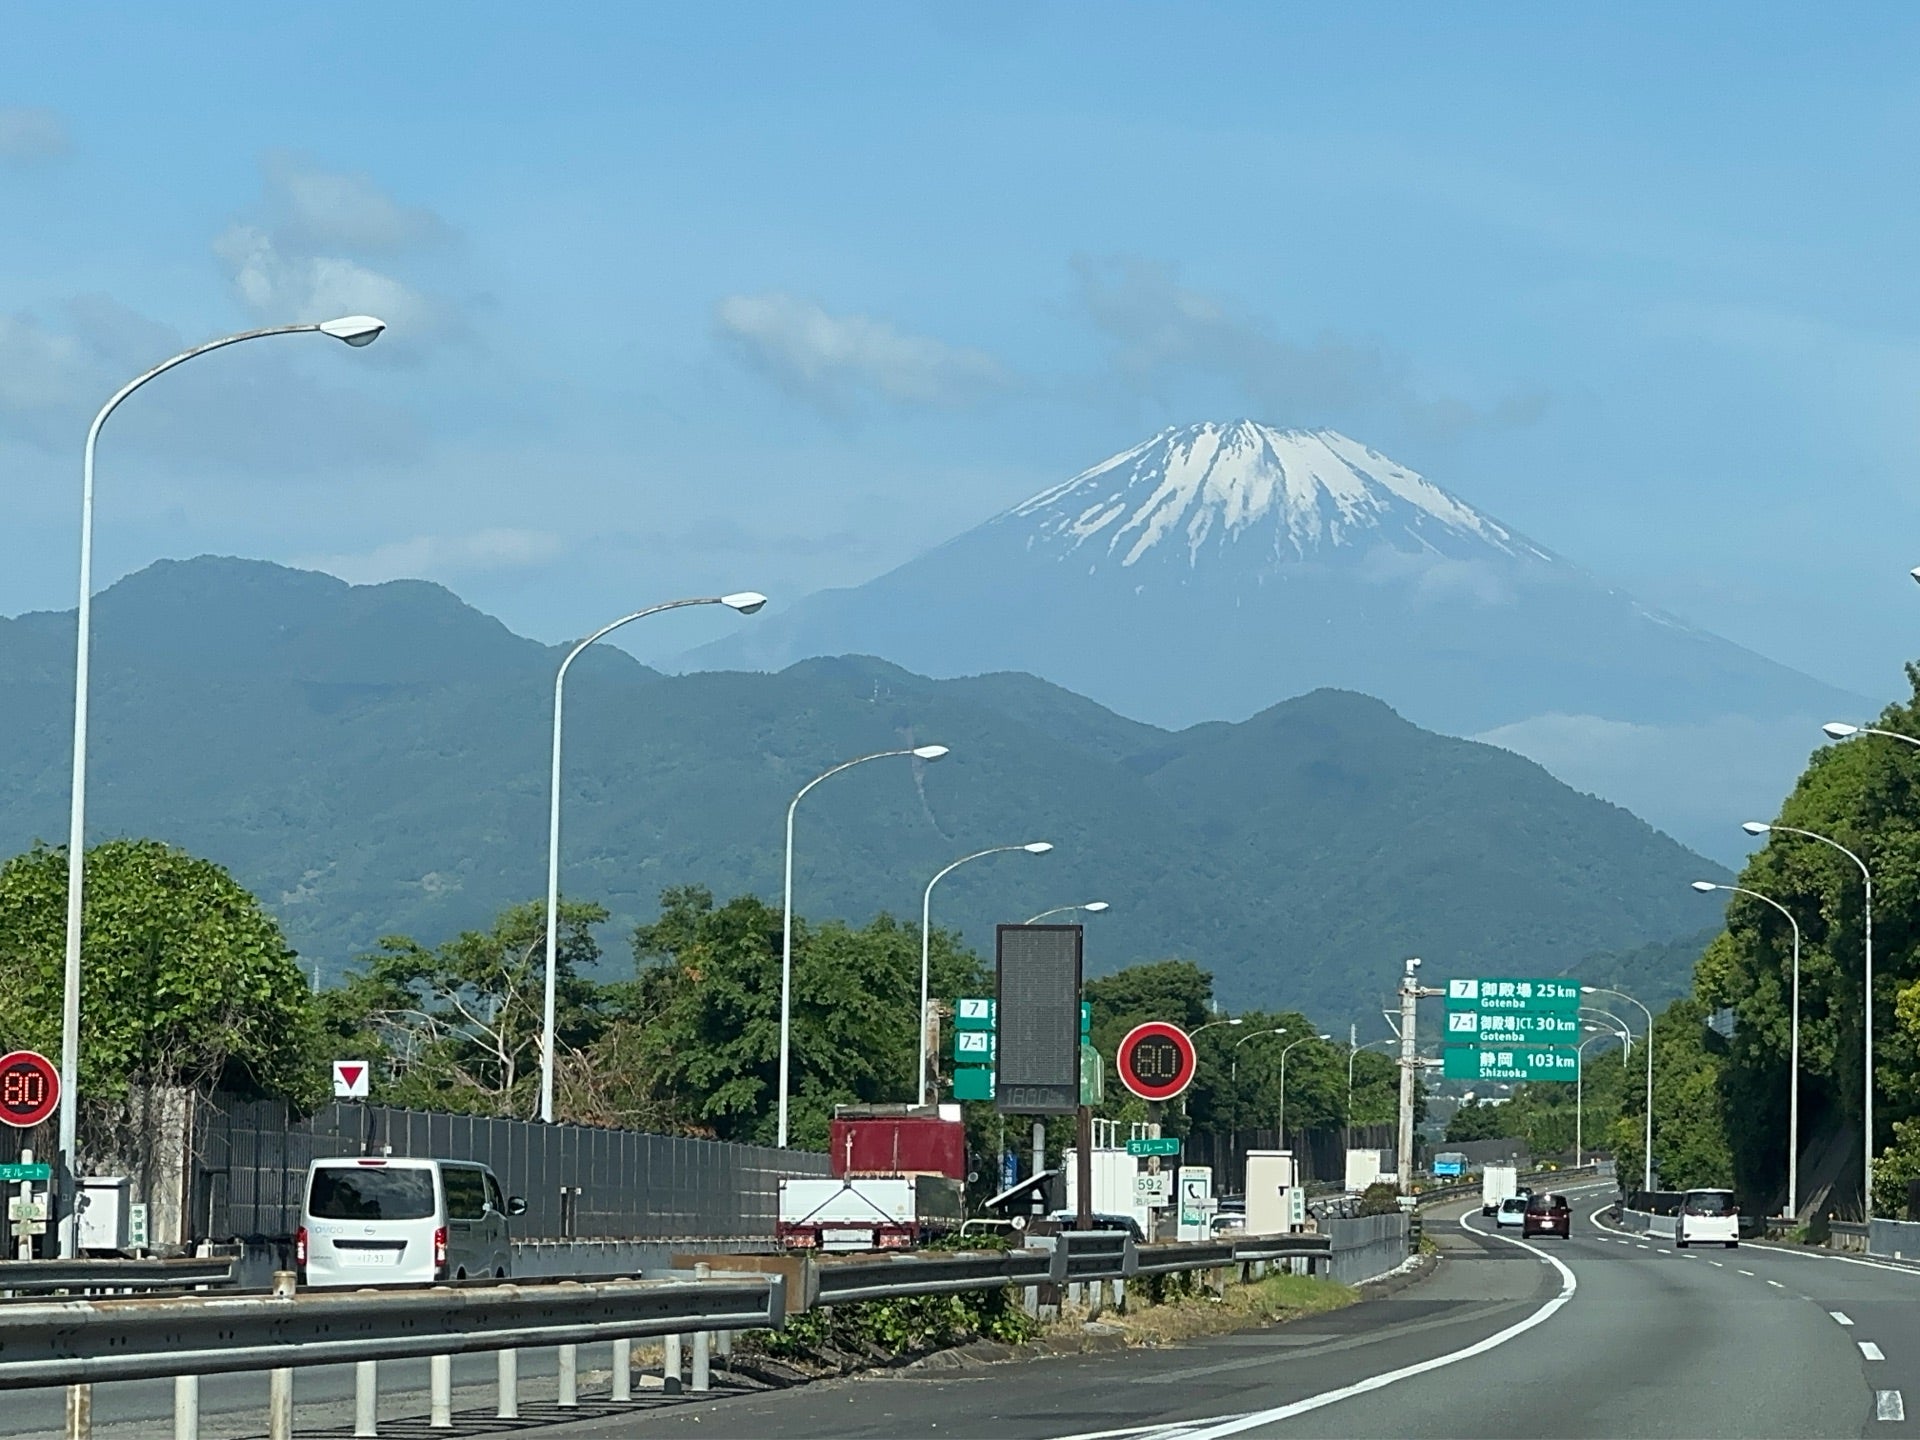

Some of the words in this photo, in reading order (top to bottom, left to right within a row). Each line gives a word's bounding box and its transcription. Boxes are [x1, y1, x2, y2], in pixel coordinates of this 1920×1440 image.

[1458, 982, 1470, 996] 7
[1480, 982, 1532, 998] 御殿場
[969, 1001, 979, 1016] 7
[1480, 998, 1526, 1009] Gotenba
[1452, 1015, 1474, 1029] 7-1
[962, 1035, 984, 1049] 7-1
[1479, 1031, 1525, 1042] Gotenba
[1136, 1044, 1176, 1077] 80
[1479, 1051, 1514, 1068] 静岡
[1479, 1067, 1528, 1079] Shizuoka
[4, 1072, 43, 1105] 80
[1131, 1142, 1174, 1153] 右ルート
[2, 1167, 44, 1178] 左ルート
